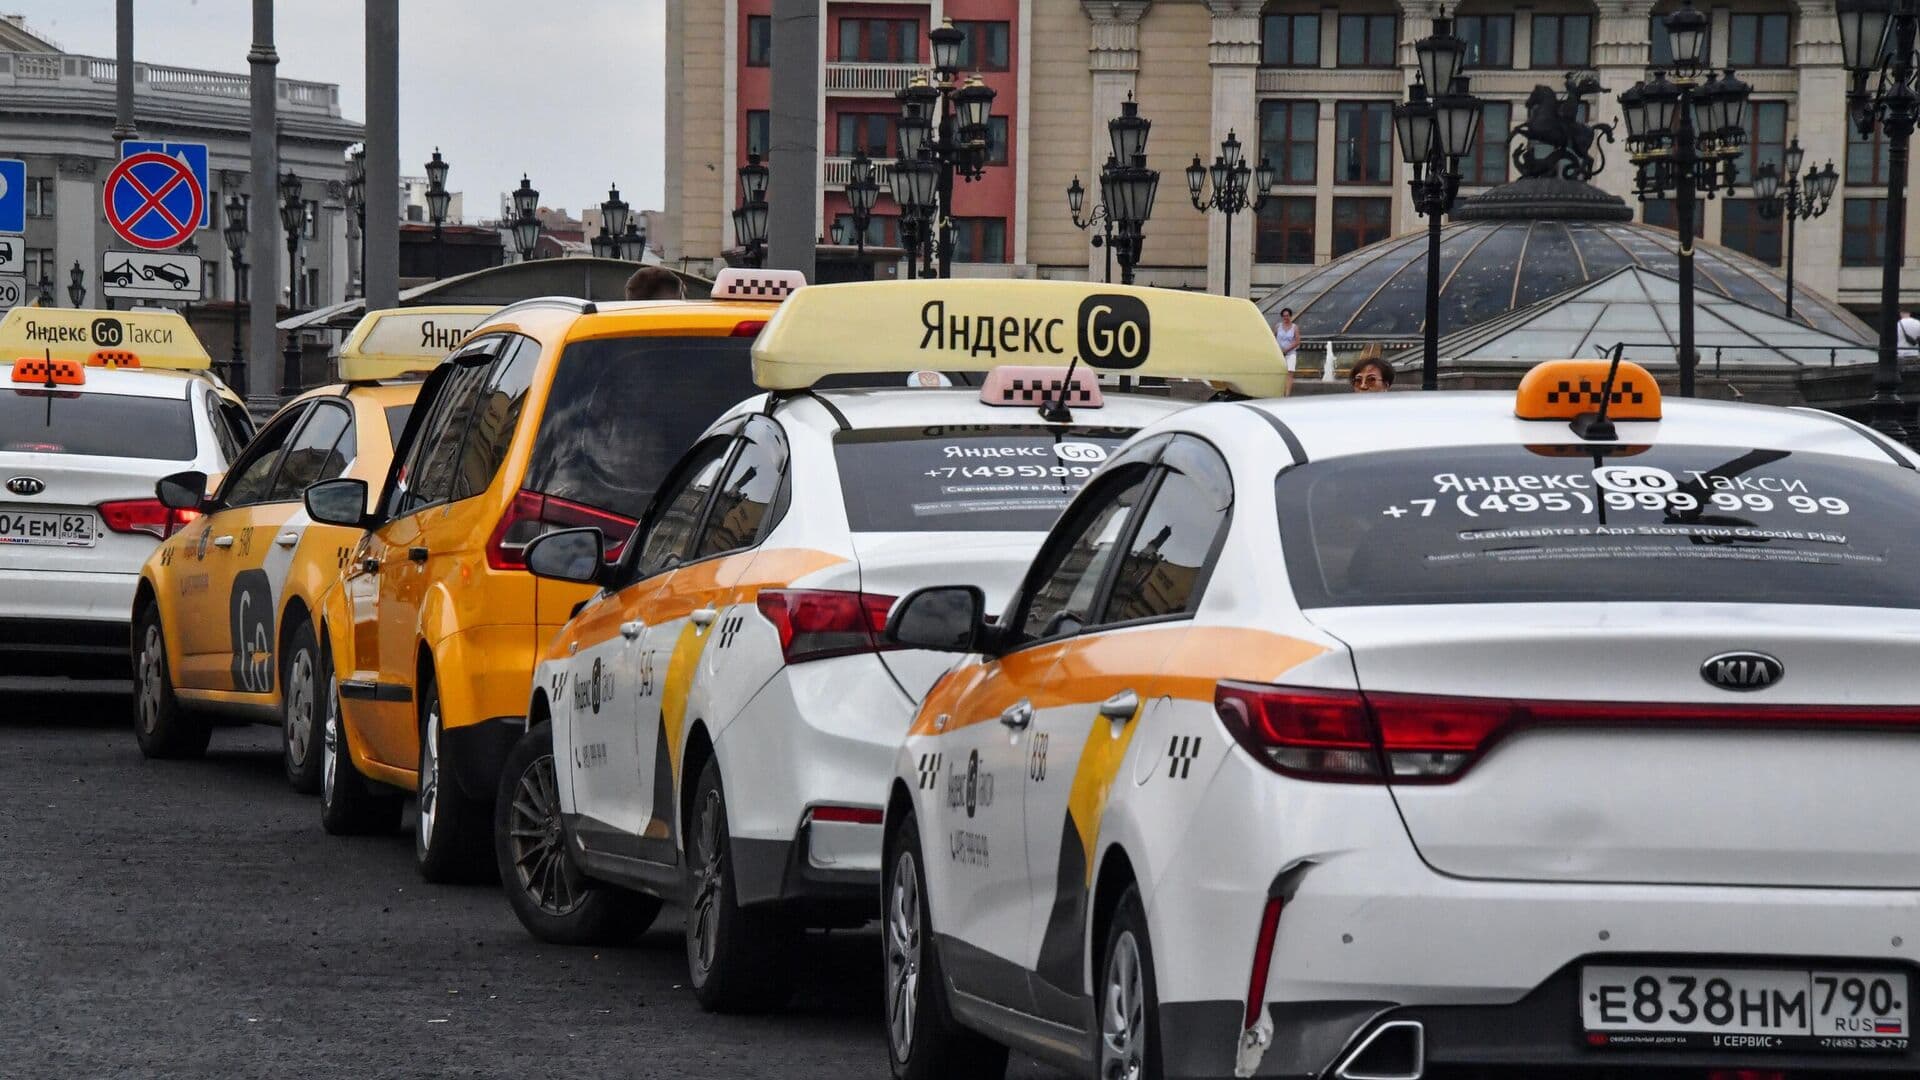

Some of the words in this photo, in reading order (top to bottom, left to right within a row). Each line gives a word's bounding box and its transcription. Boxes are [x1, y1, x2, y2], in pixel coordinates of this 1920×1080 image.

[25, 320, 87, 343] Яндекс
[93, 319, 121, 345] Go
[126, 323, 173, 344] Такси
[421, 320, 473, 352] Янд
[920, 300, 1064, 358] Яндекс
[1084, 302, 1145, 360] Go
[943, 445, 1048, 458] Яндекс
[1057, 444, 1103, 460] Go
[12, 479, 39, 491] KIA
[1433, 472, 1590, 493] Яндекс
[1601, 467, 1671, 490] Go
[1683, 470, 1808, 493] Такси
[1383, 498, 1437, 518] +7
[1456, 491, 1594, 517] (495)
[1603, 492, 1698, 511] 999
[1711, 492, 1774, 512] 99
[1787, 495, 1850, 515] 99
[63, 516, 85, 533] 62
[1459, 527, 1575, 541] Скачивайте
[1596, 526, 1635, 536] App
[1638, 526, 1690, 535] Store
[1694, 527, 1731, 536] или
[1735, 527, 1804, 540] Google
[1807, 532, 1847, 544] Play
[639, 649, 656, 697] 545
[1717, 661, 1770, 683] KIA
[1030, 732, 1049, 782] 838
[1815, 977, 1893, 1016] 790
[1836, 1018, 1873, 1031] RUS
[1724, 1036, 1772, 1047] СЕРВИС
